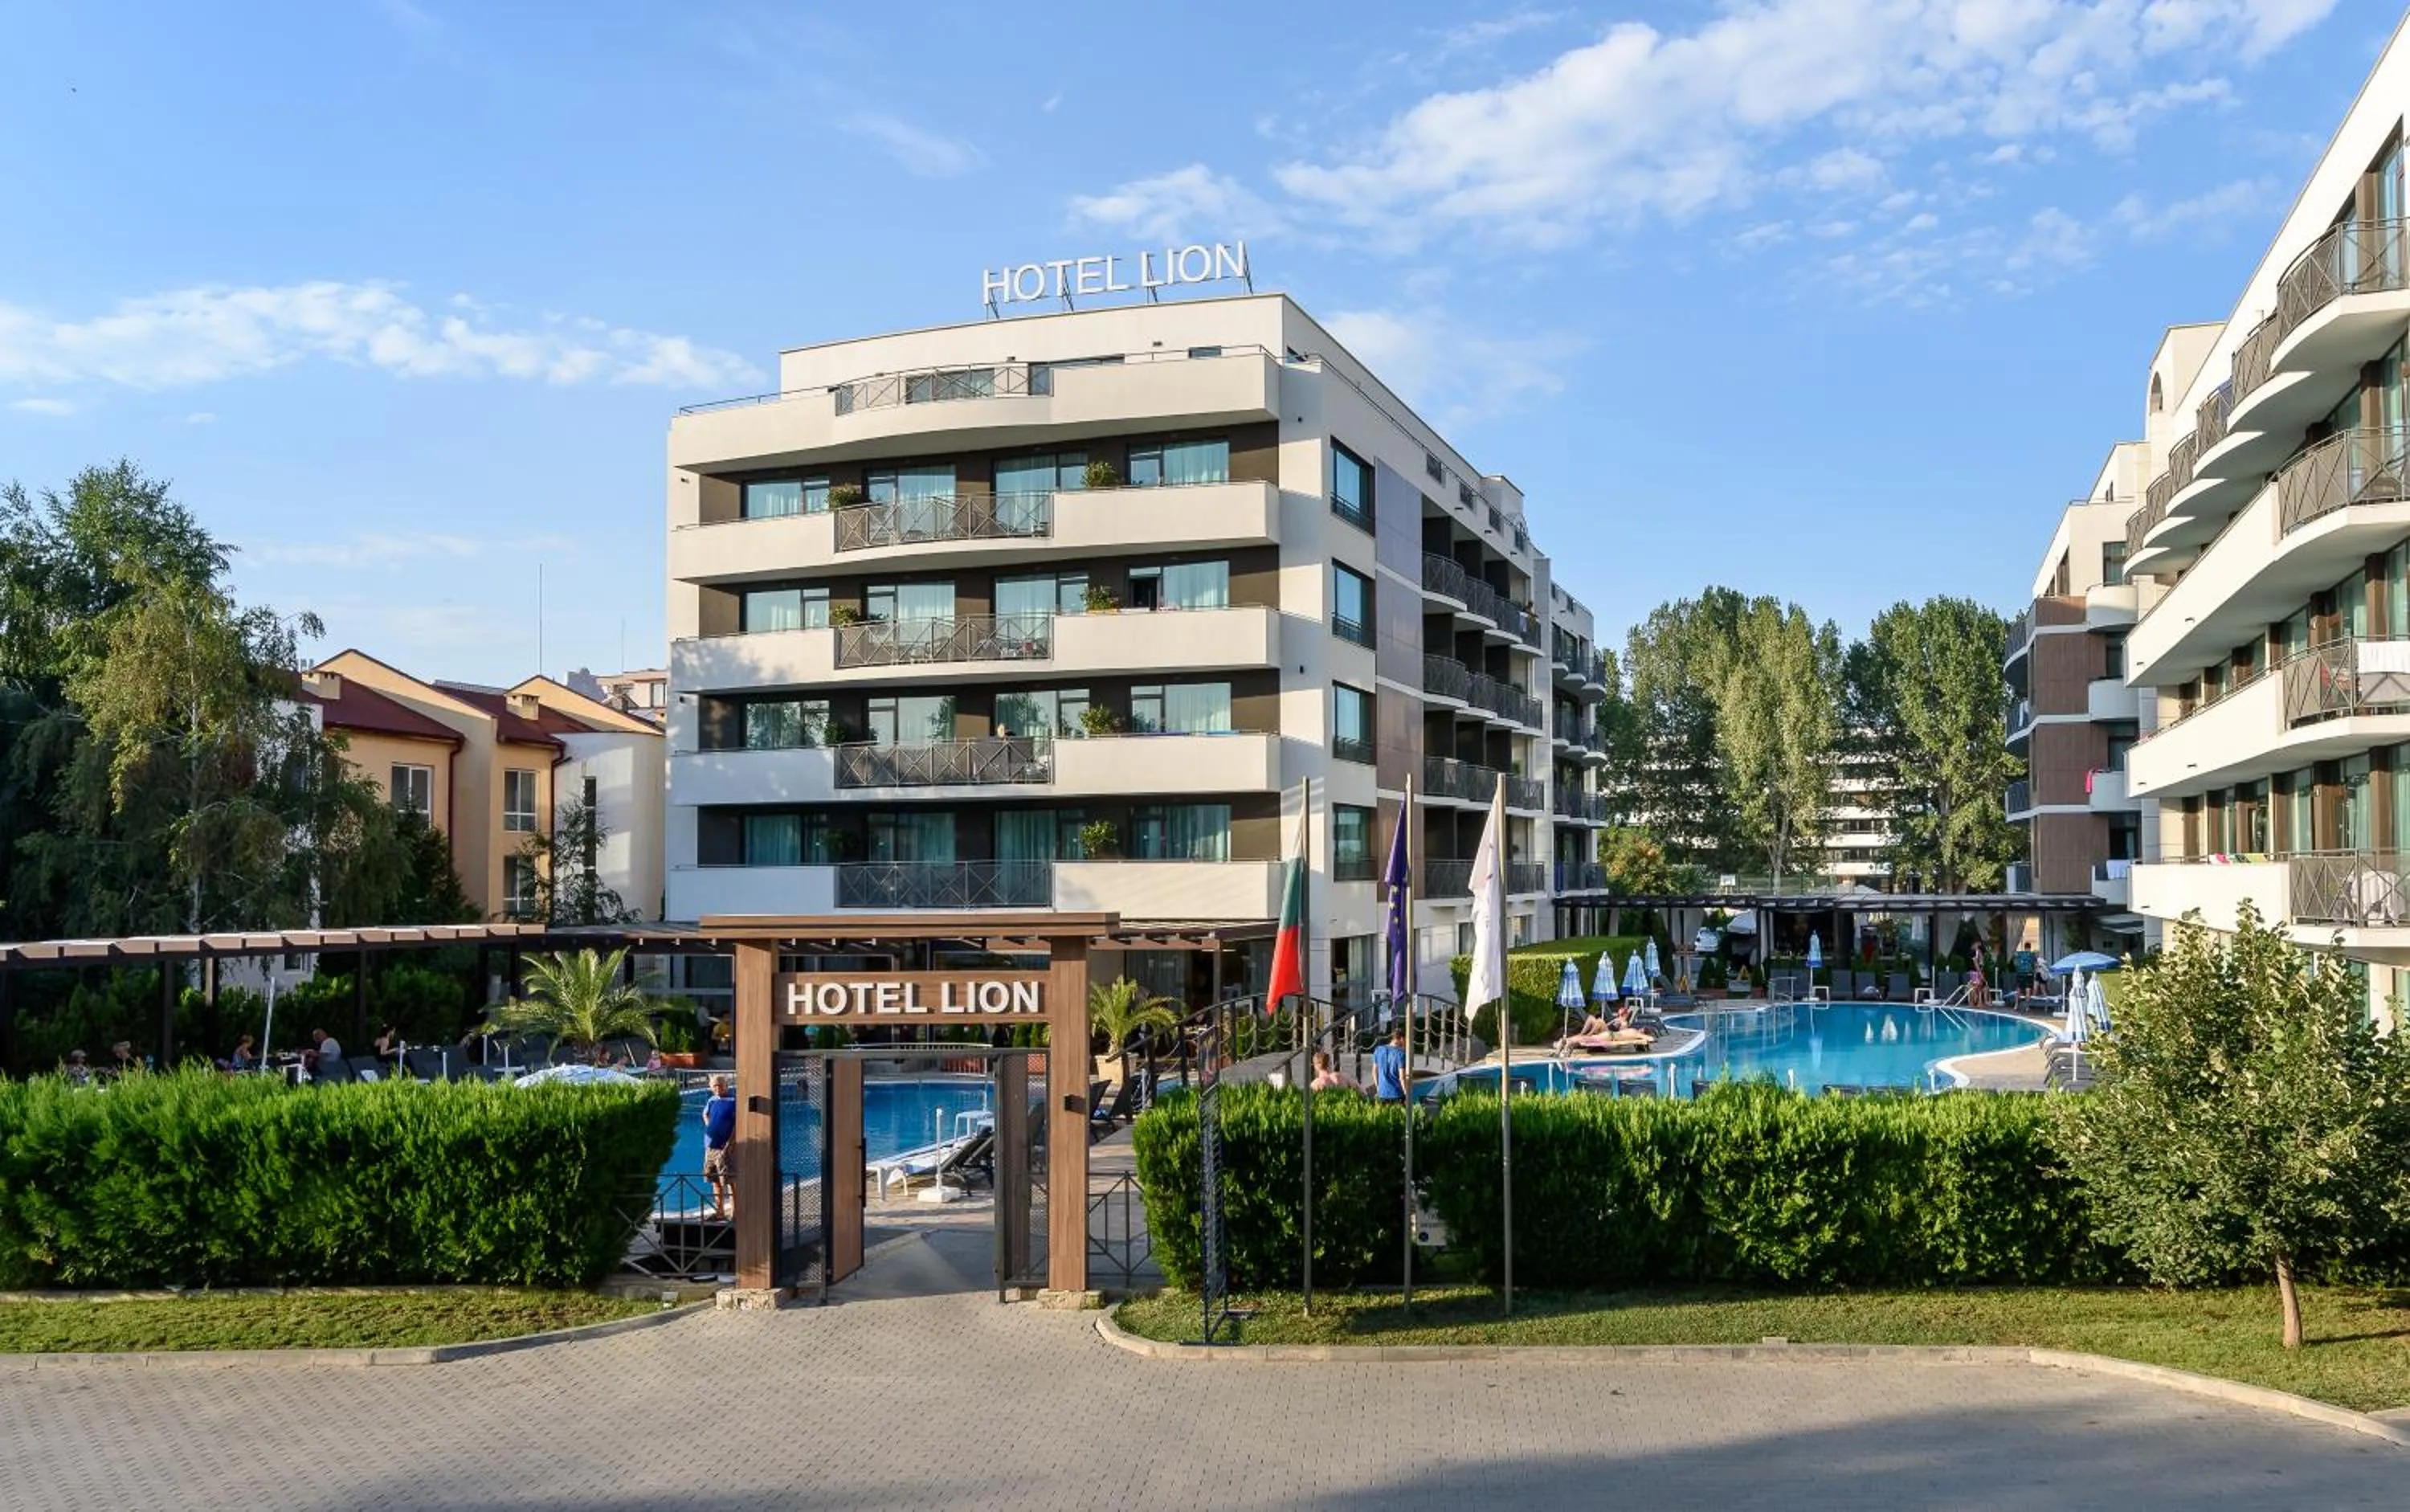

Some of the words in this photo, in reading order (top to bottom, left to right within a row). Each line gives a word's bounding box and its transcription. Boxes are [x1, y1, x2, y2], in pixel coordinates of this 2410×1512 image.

[982, 255, 1129, 304] HOTEL
[1141, 240, 1246, 288] LION
[786, 982, 928, 1015] HOTEL
[941, 980, 1040, 1014] LION
